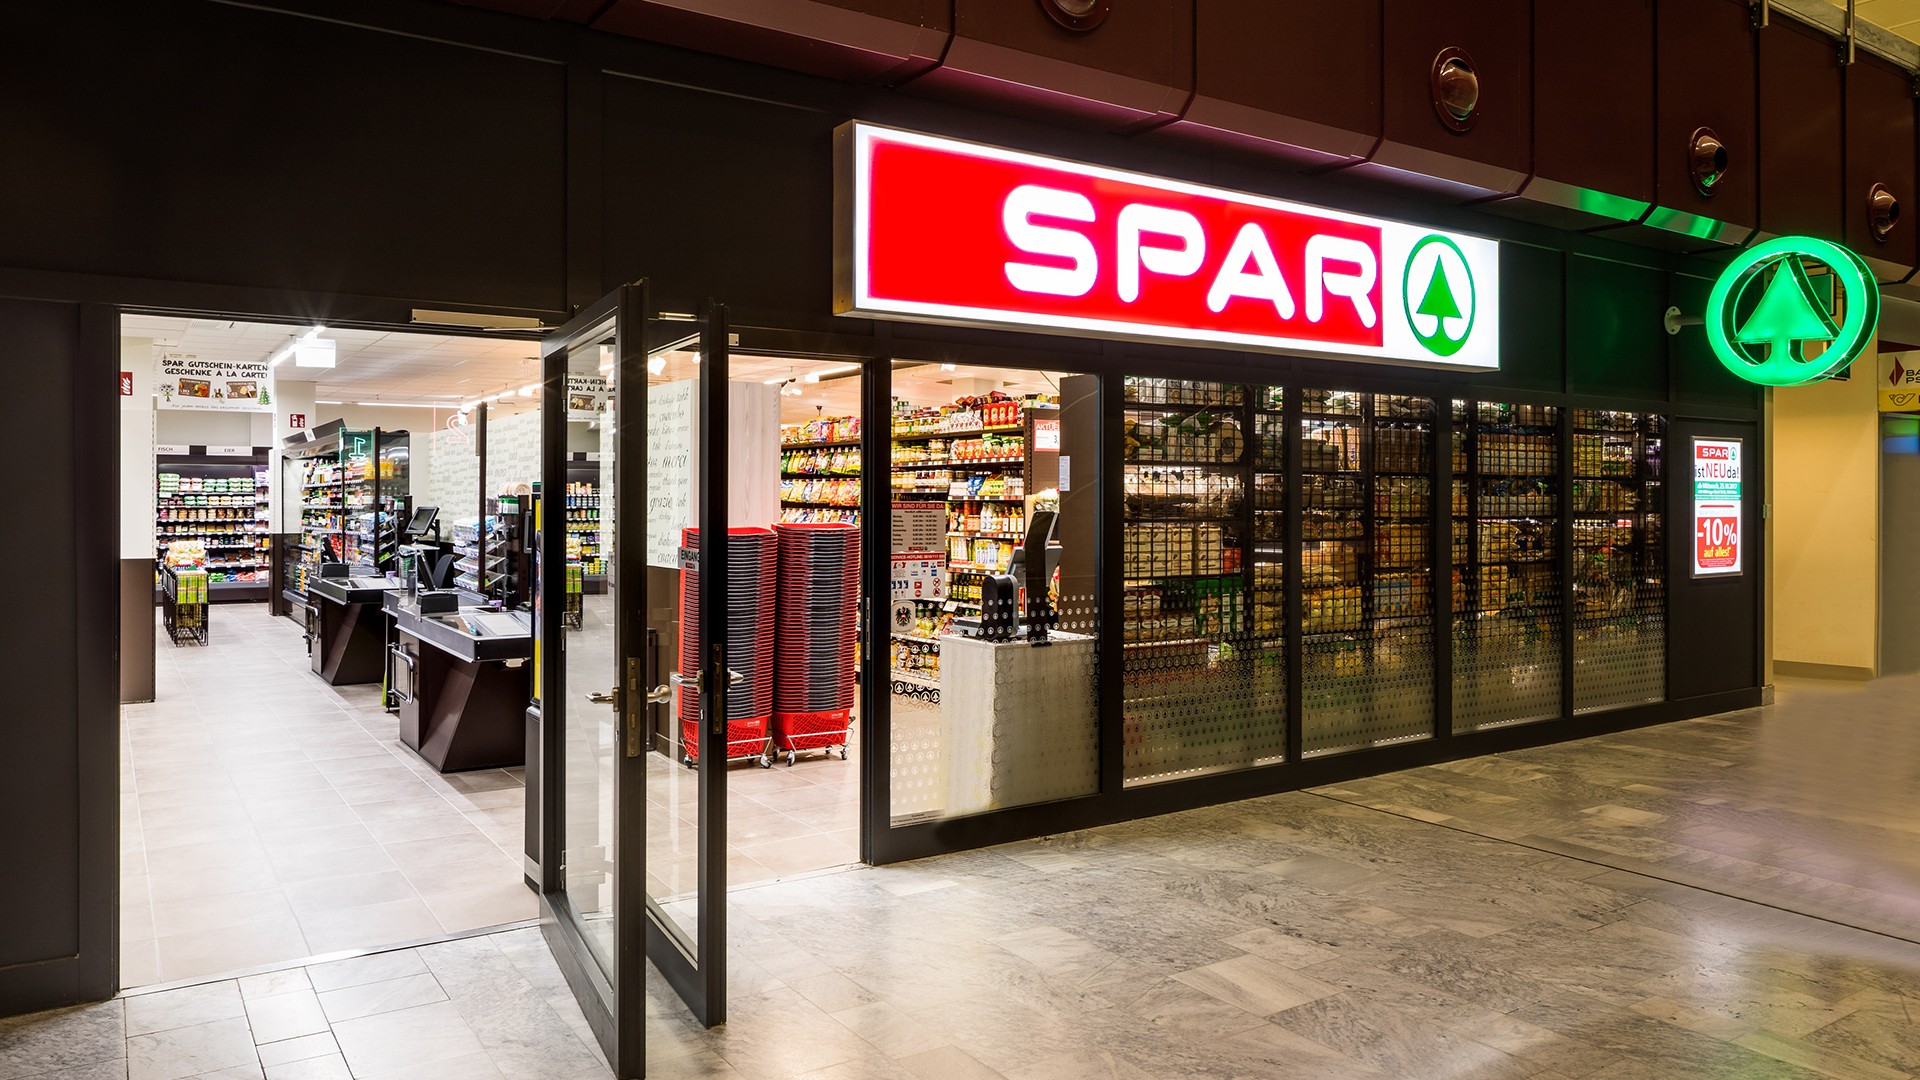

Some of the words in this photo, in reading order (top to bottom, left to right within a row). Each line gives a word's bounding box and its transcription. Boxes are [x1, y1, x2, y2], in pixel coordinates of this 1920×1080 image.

[1003, 184, 1377, 328] SPAR
[188, 361, 268, 371] GUTSCHEIN-KARTEN
[165, 368, 212, 377] GESCHENKE
[1702, 447, 1728, 458] SPAR
[1706, 463, 1726, 478] NEU
[1697, 518, 1737, 546] -10%
[1703, 546, 1714, 558] auf
